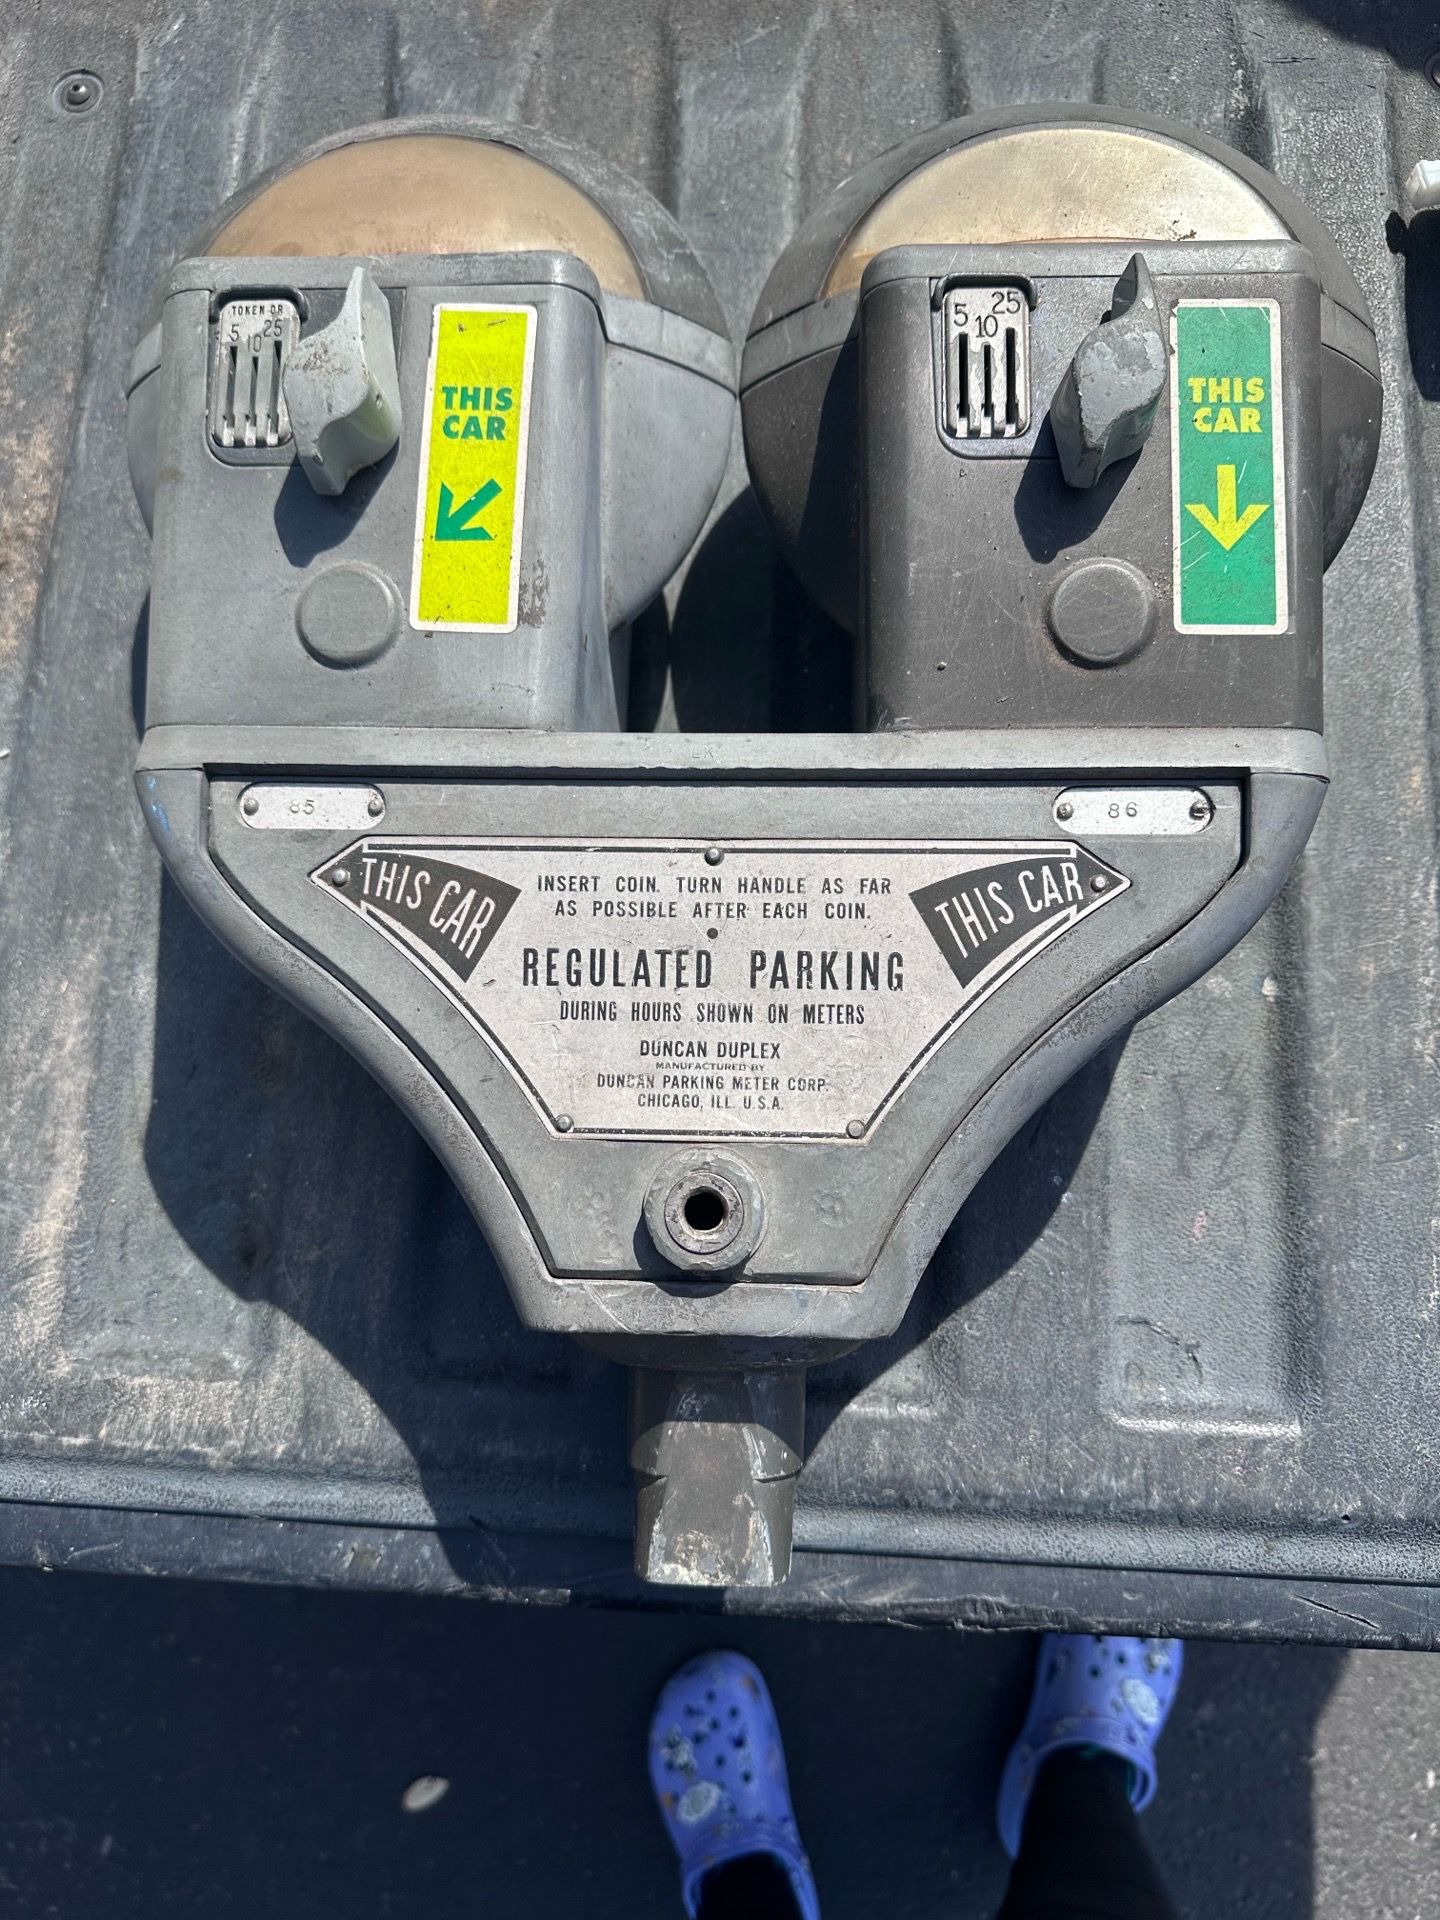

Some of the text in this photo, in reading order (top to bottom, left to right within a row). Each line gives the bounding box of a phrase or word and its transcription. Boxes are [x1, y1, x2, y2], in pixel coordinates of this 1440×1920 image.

[231, 304, 283, 316] TOKEN OR
[953, 291, 1021, 338] 5 10 25
[229, 318, 283, 352] 5 10 25
[441, 386, 513, 411] THIS
[1188, 377, 1264, 404] THIS
[442, 415, 507, 441] CAR
[1193, 407, 1263, 433] CAR
[289, 799, 315, 815] 85
[1108, 801, 1137, 819] 86
[537, 875, 601, 892] INSERT
[676, 877, 722, 893] TURN
[737, 878, 806, 894] HANDLE
[821, 878, 844, 894] AS
[859, 878, 891, 894] FAR
[361, 857, 496, 960] THIS CAR
[555, 900, 872, 919] AS POSSIBLE AFTER EACH COIN.
[934, 862, 1084, 958] THIS CAR
[522, 948, 904, 991] REGULATED PARKING
[560, 1000, 866, 1024] DURING HOURS SHOWN ON METERS
[640, 1039, 781, 1059] DUNCAN DUPLEX
[655, 1061, 765, 1071] MANUFACTURED BY
[597, 1073, 829, 1092] DUNCAN PARKING METER CORP.
[637, 1093, 704, 1112] CHICAGO,
